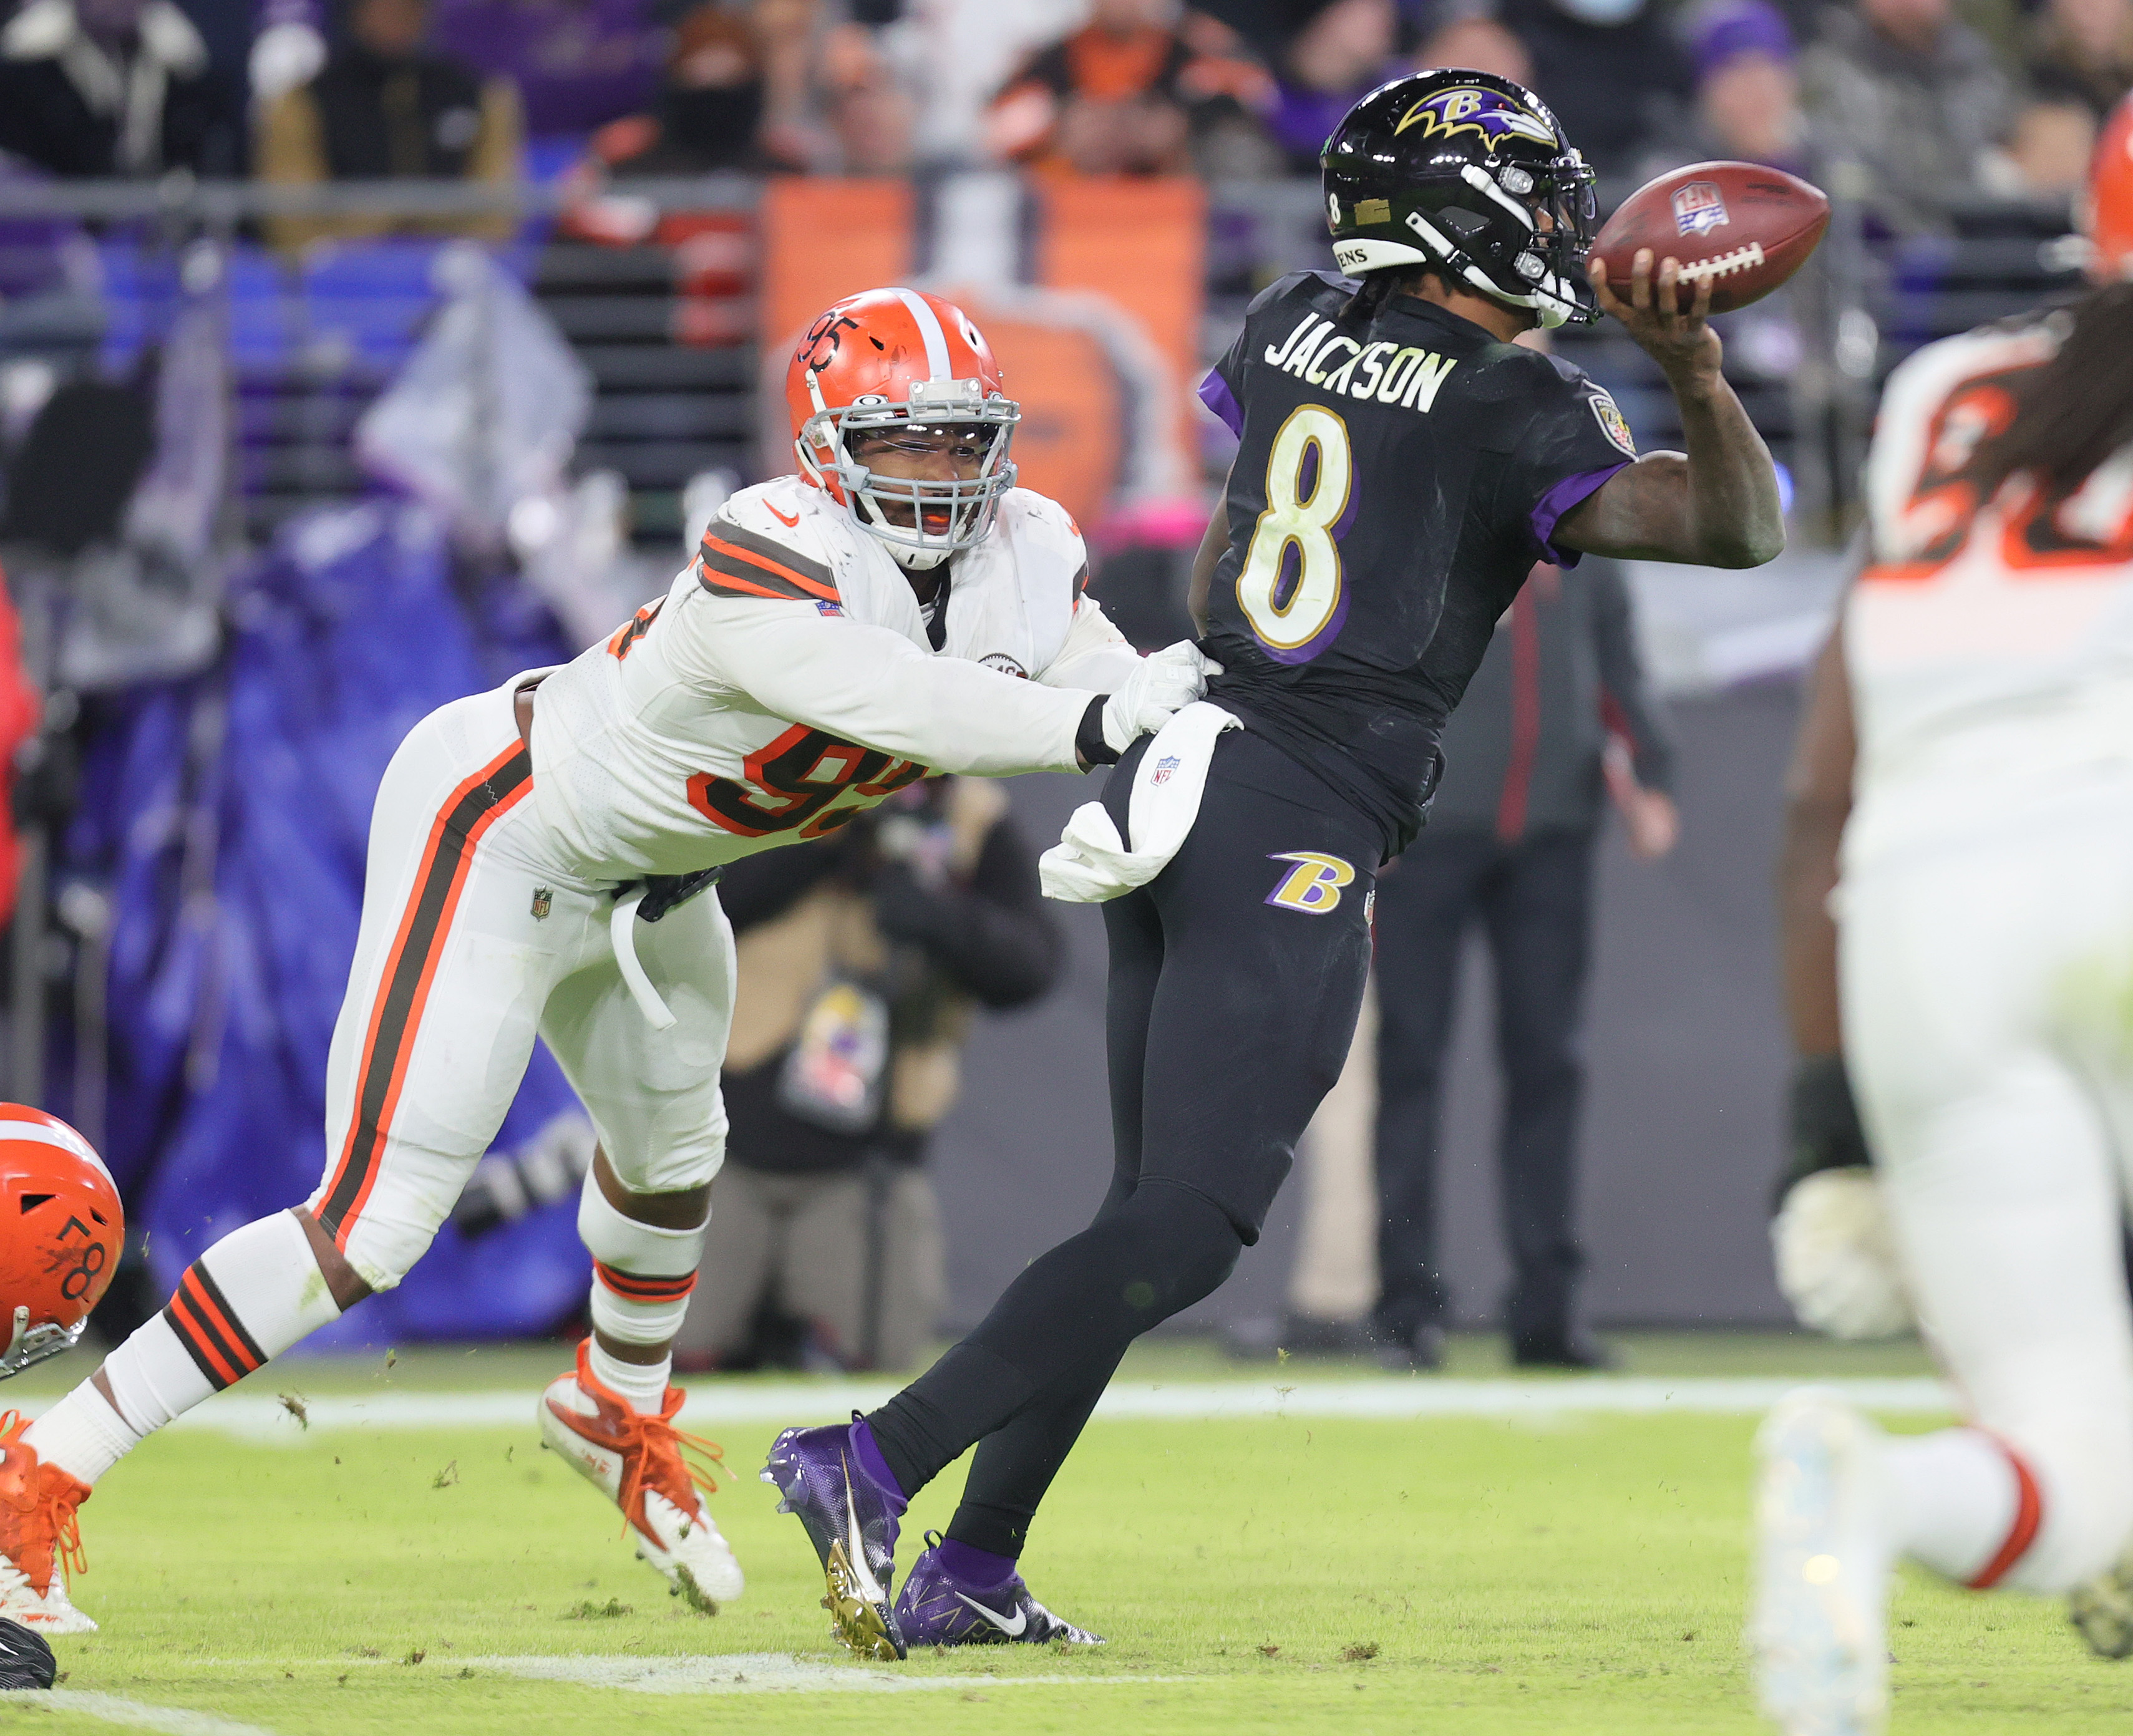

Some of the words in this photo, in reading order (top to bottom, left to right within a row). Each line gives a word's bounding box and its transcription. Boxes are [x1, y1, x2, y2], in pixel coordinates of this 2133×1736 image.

[1329, 193, 1341, 225] 8
[1337, 249, 1368, 267] ENS
[798, 311, 860, 373] 95
[1265, 312, 1458, 413] JACKSON
[1236, 404, 1357, 656] 8
[1154, 770, 1172, 784] NFL
[1266, 851, 1356, 914] B
[535, 900, 550, 914] NFL
